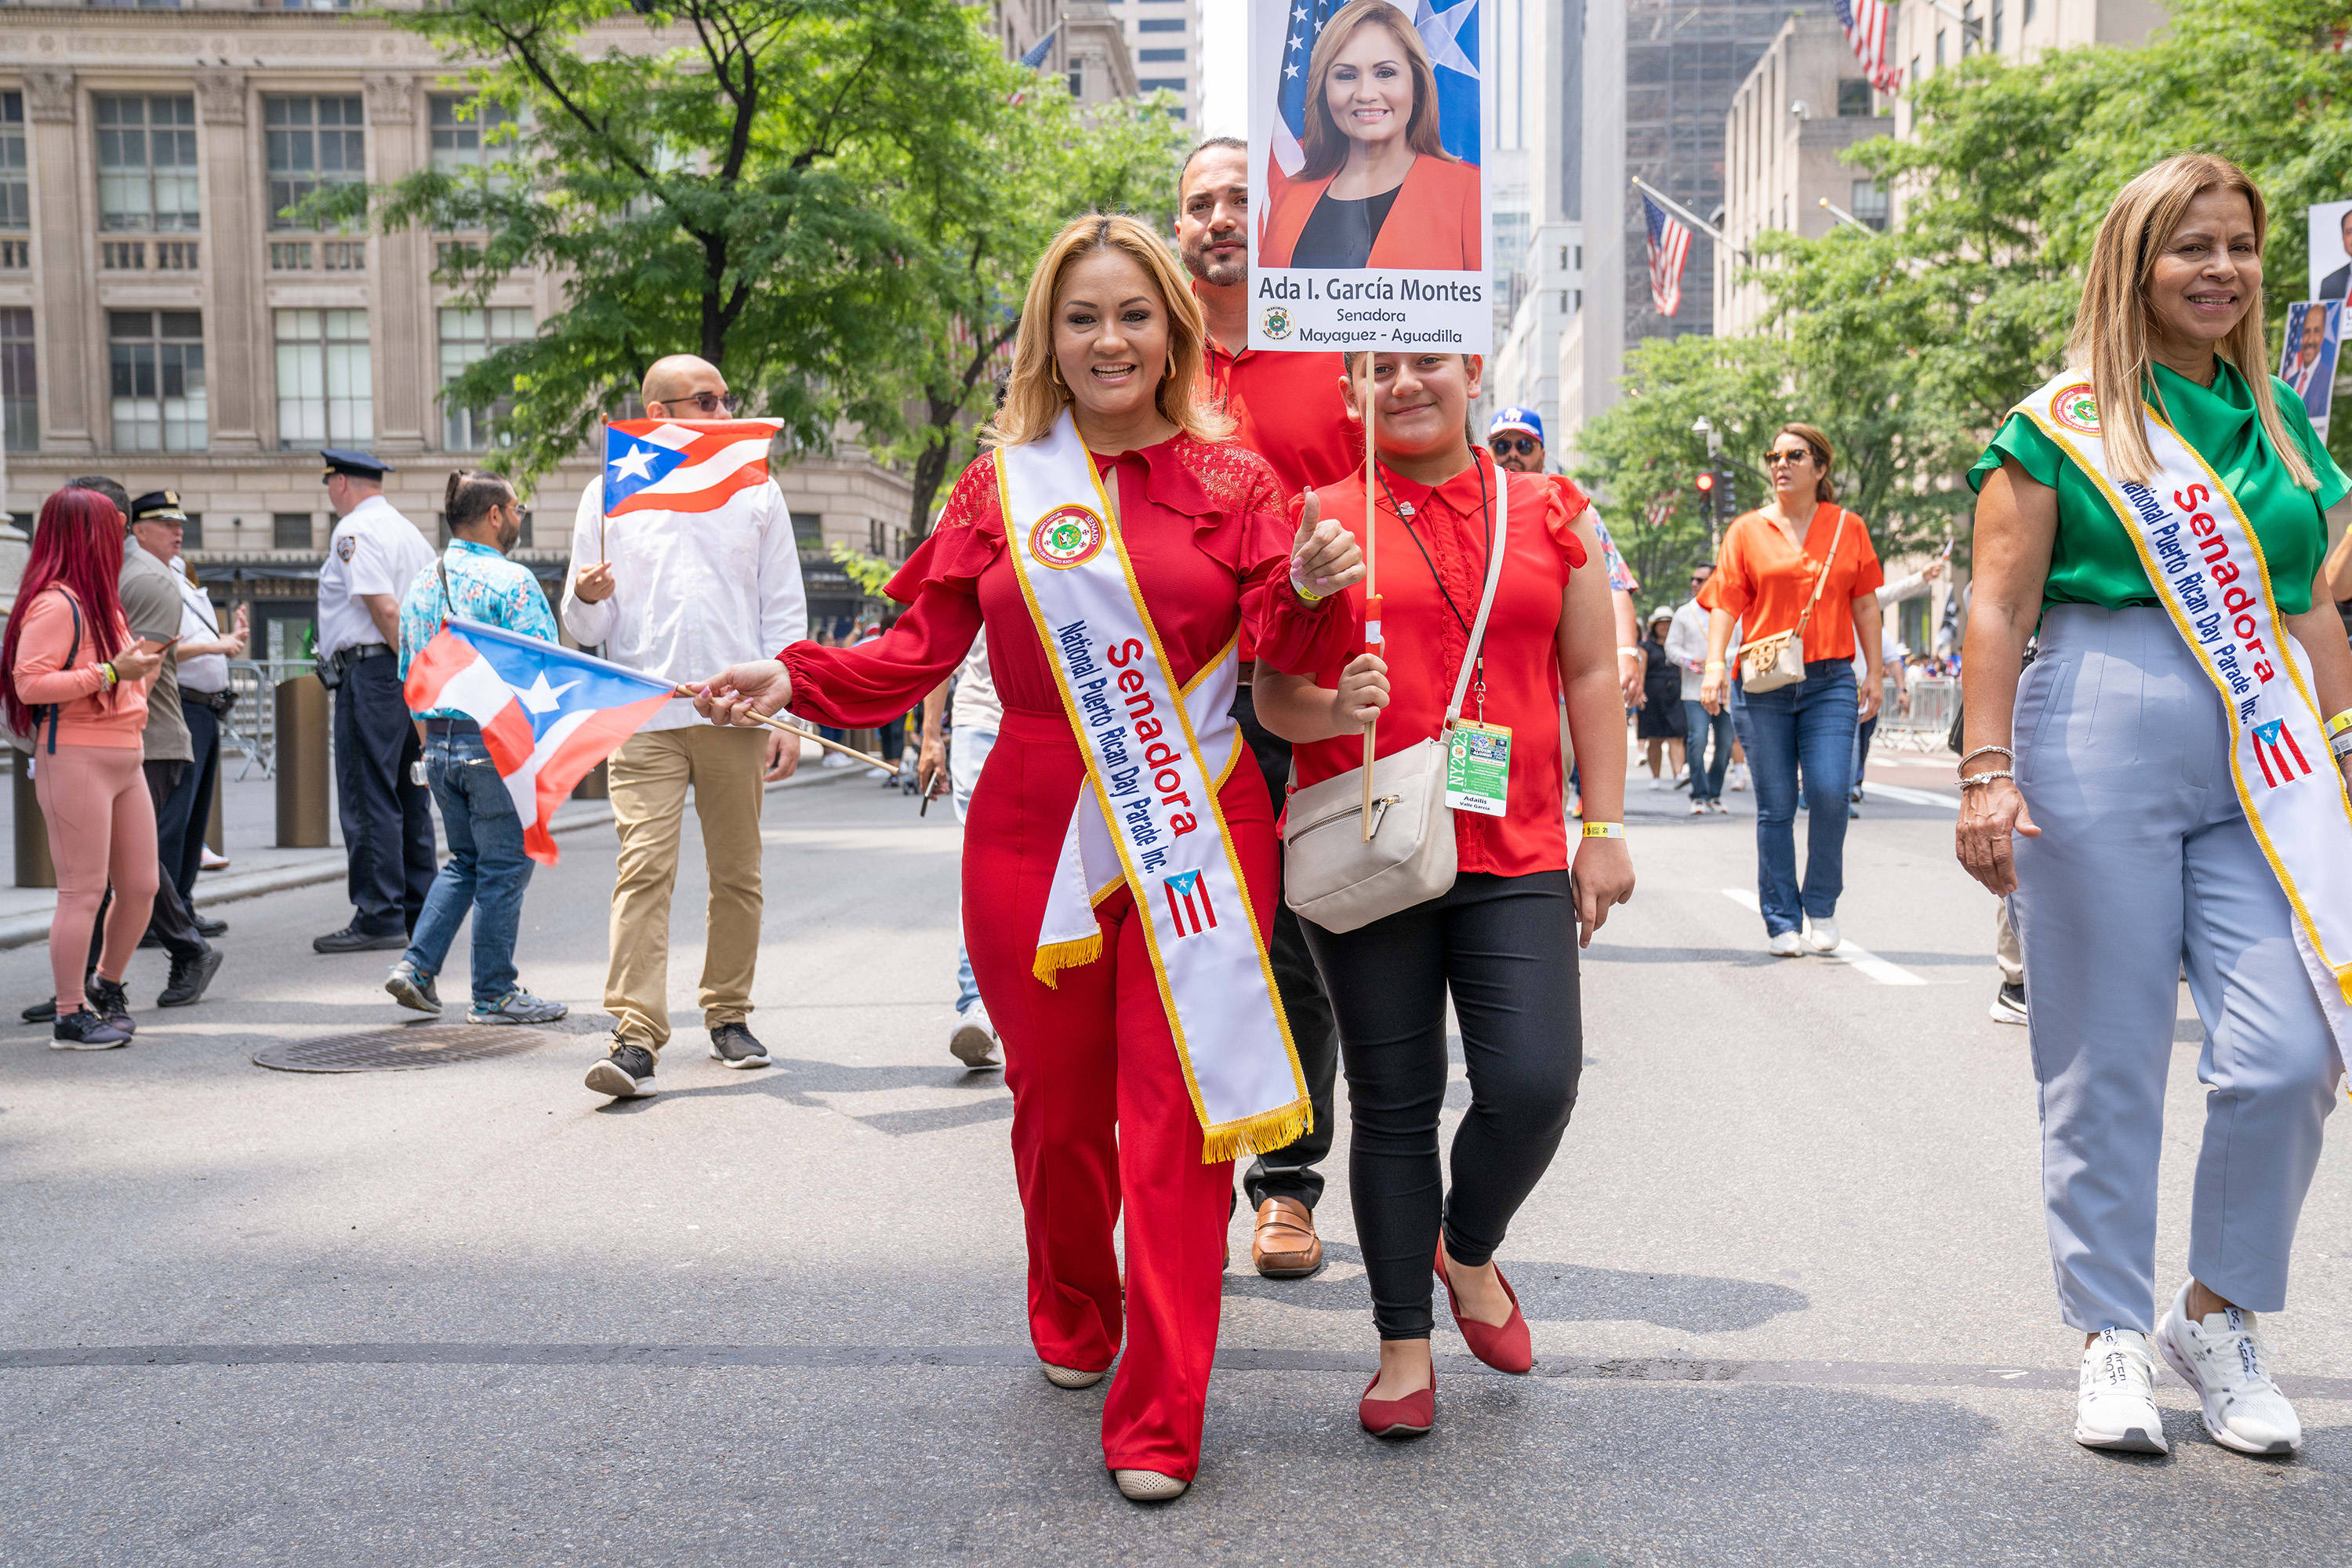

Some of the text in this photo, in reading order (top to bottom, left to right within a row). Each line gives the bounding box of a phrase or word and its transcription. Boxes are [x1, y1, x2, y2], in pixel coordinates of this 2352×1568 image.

[1258, 276, 1482, 303] Ada I. García Montes
[1337, 308, 1406, 322] Senadora
[1300, 328, 1377, 344] Mayaguez
[1391, 328, 1462, 343] Aguadilla
[1085, 515, 1099, 545] SENADO
[2174, 483, 2275, 685] Senadora
[2152, 521, 2191, 574] Puerto
[2174, 572, 2209, 615] Rican
[2196, 612, 2223, 645] Day
[2213, 643, 2252, 695] Parade
[2241, 694, 2260, 724] Inc.
[1057, 619, 1169, 873] National Puerto Rican Day Parade Inc.
[1107, 638, 1198, 838] Senadora
[1449, 730, 1468, 787] NY2023
[1462, 788, 1489, 797] PARTICIPANTE
[1464, 795, 1487, 804] Adailis
